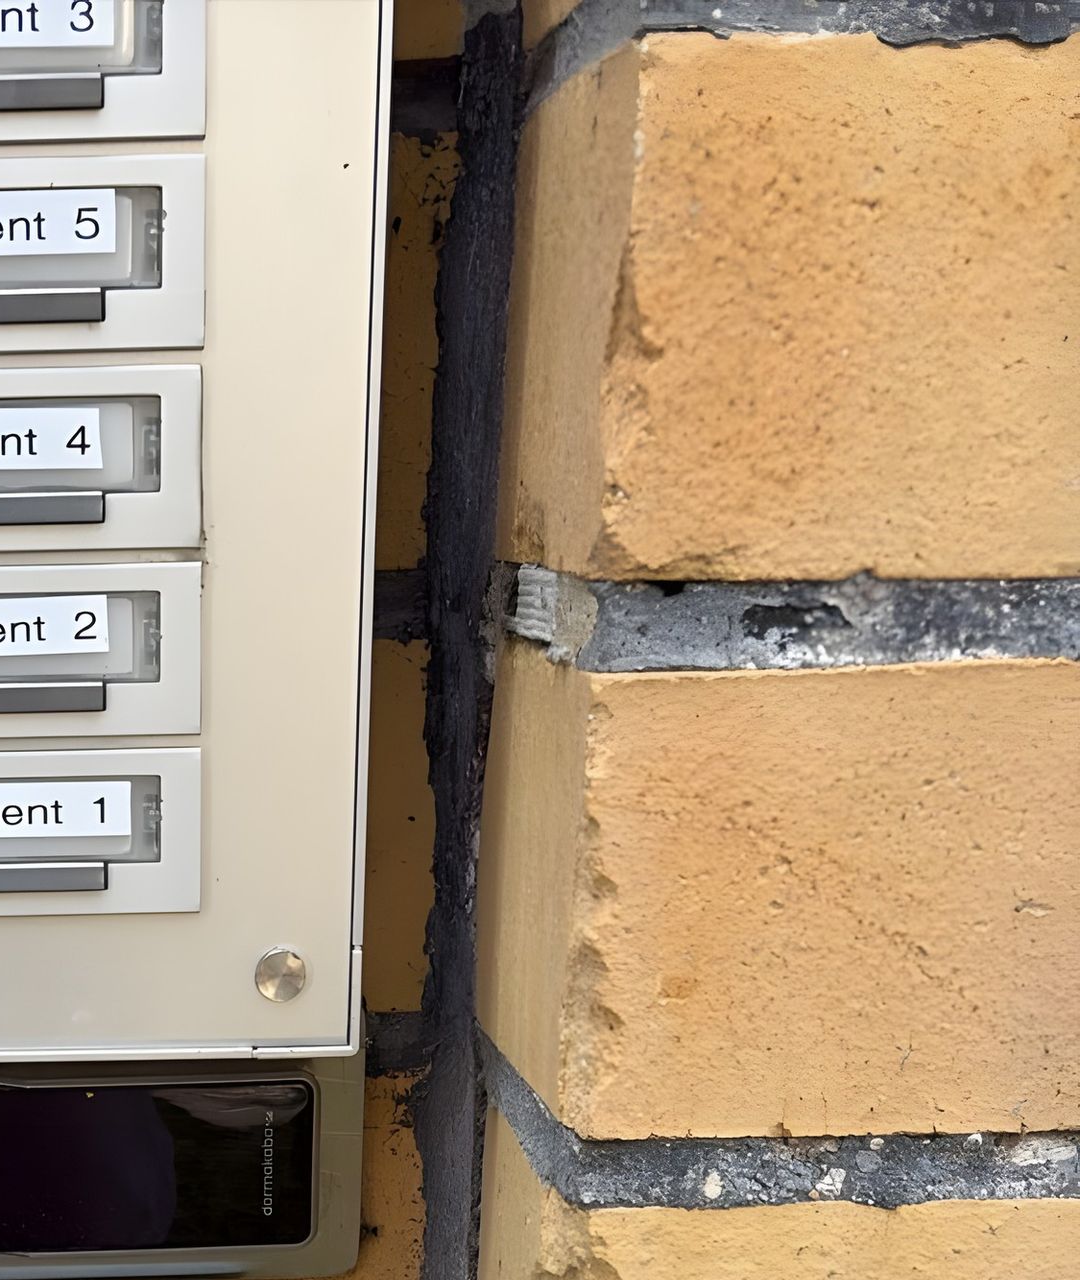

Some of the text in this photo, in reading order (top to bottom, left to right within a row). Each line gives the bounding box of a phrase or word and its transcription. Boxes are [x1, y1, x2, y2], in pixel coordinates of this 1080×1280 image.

[69, 0, 94, 33] 3
[74, 207, 100, 240] 5
[65, 425, 91, 456] 4
[74, 611, 97, 640] 2
[93, 796, 105, 824] 1
